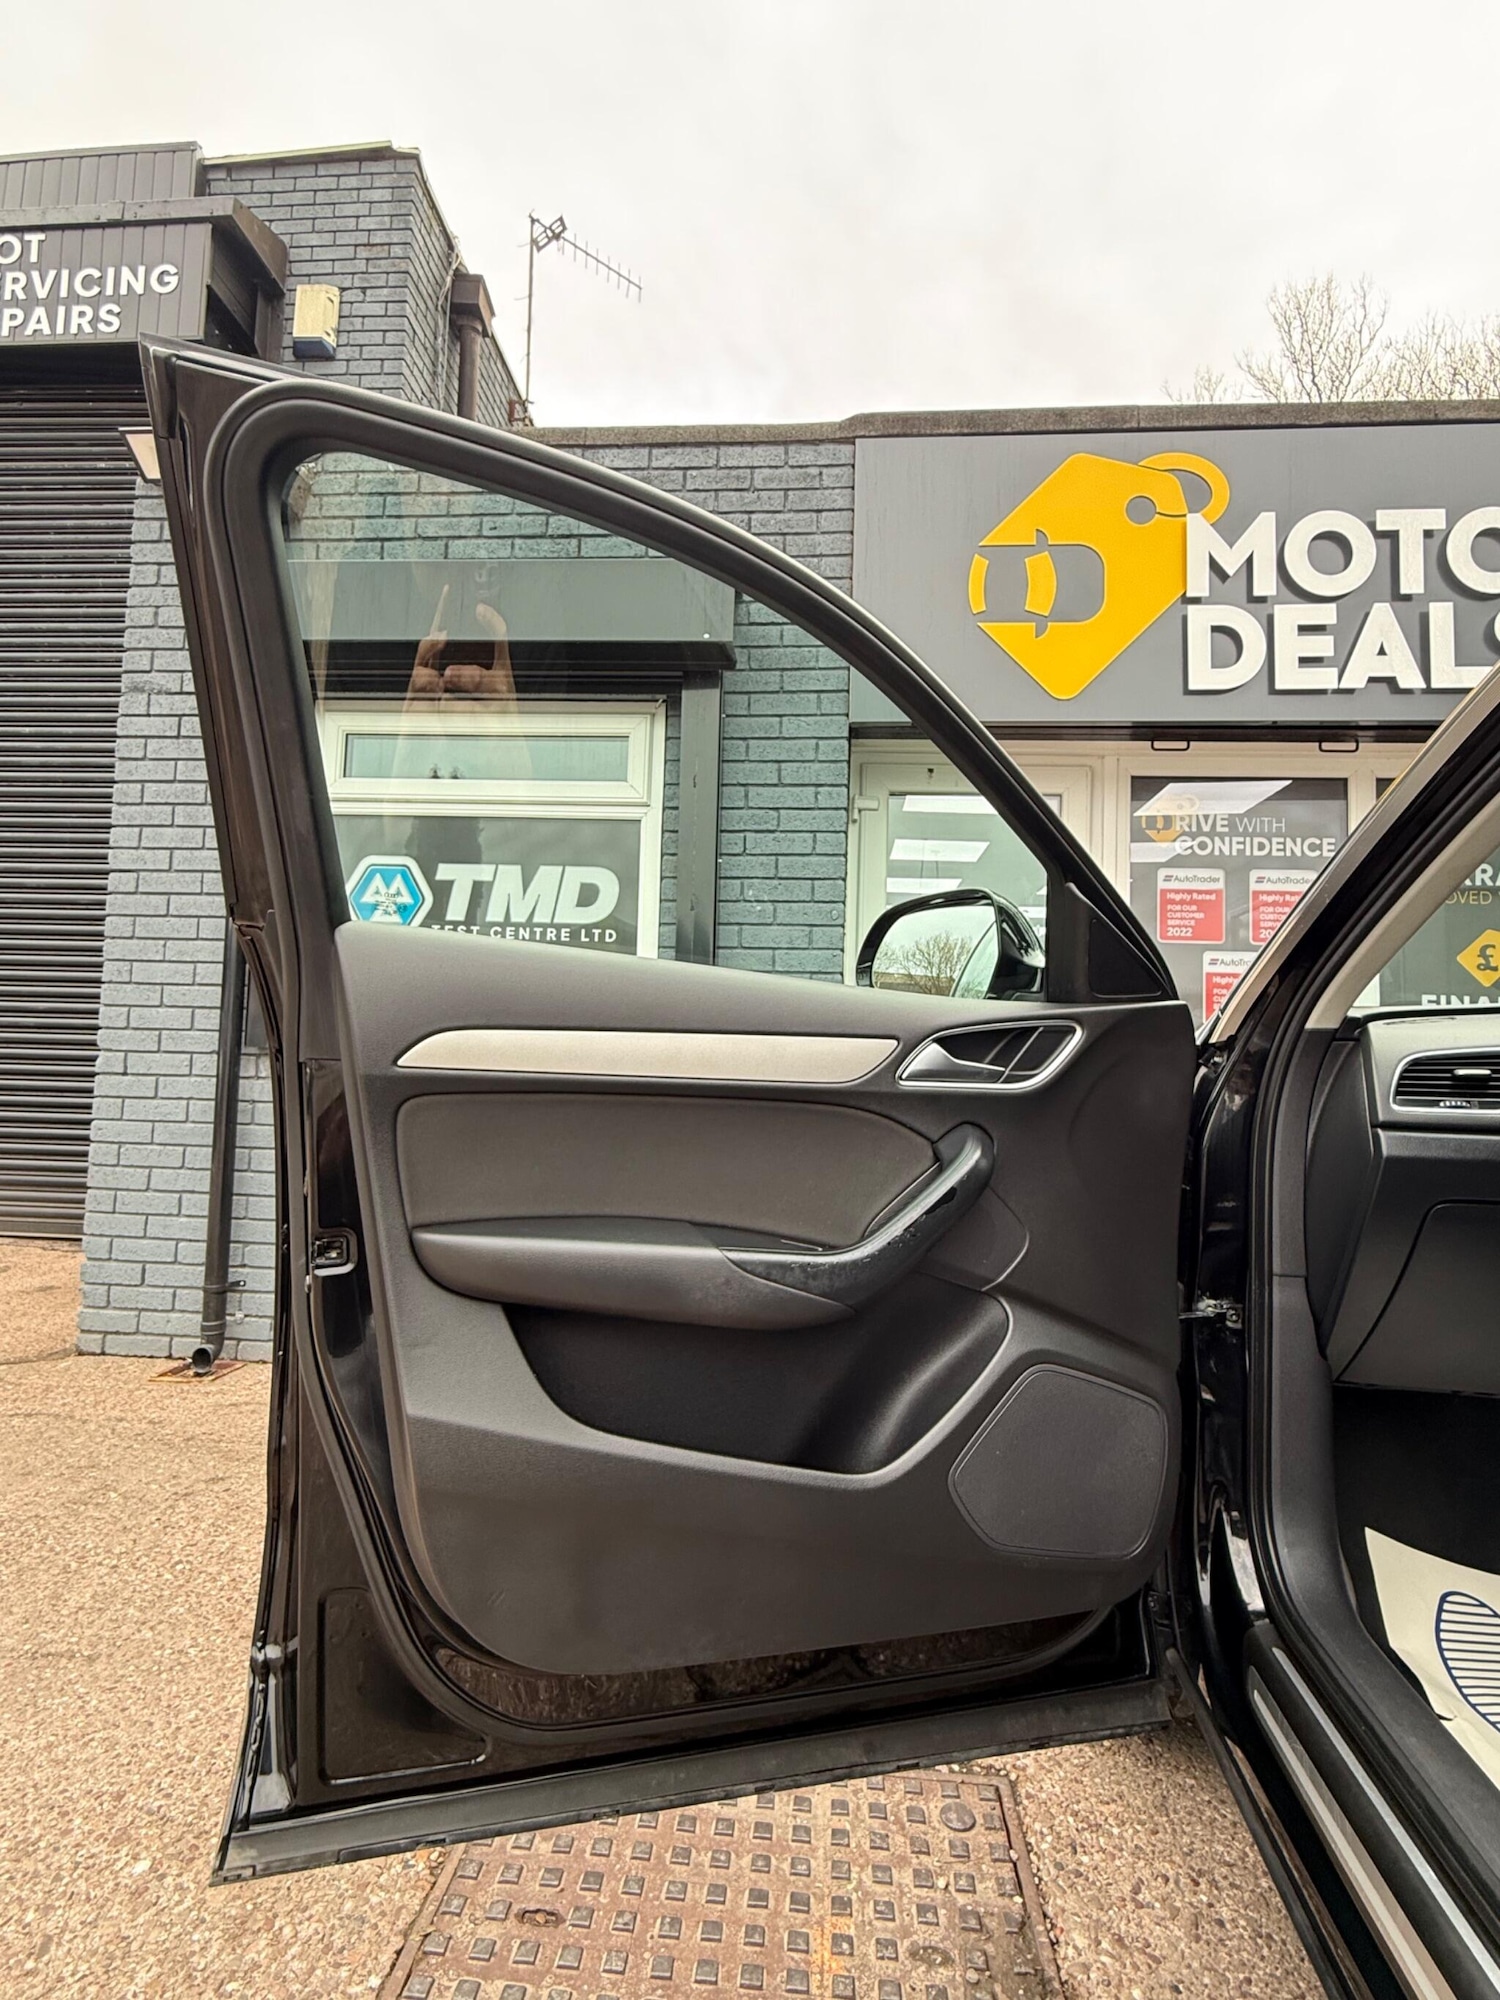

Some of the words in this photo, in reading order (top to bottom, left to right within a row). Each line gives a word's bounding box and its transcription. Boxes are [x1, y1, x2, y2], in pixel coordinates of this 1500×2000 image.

[0, 263, 180, 301] RVICING
[1, 303, 122, 337] PAIRS
[1187, 601, 1500, 691] DEAL
[1235, 816, 1286, 833] WITH
[1174, 835, 1336, 858] CONFIDENCE
[1173, 874, 1221, 884] AutoTrader
[1266, 876, 1312, 885] AutoTrade
[434, 862, 620, 925] TMD
[1166, 891, 1192, 902] Highly
[1192, 892, 1217, 901] Rated
[1285, 894, 1301, 902] Rat
[1259, 913, 1286, 921] CUSTO
[489, 926, 571, 942] CENTRE
[580, 929, 617, 943] LTD
[1166, 927, 1193, 937] 2022
